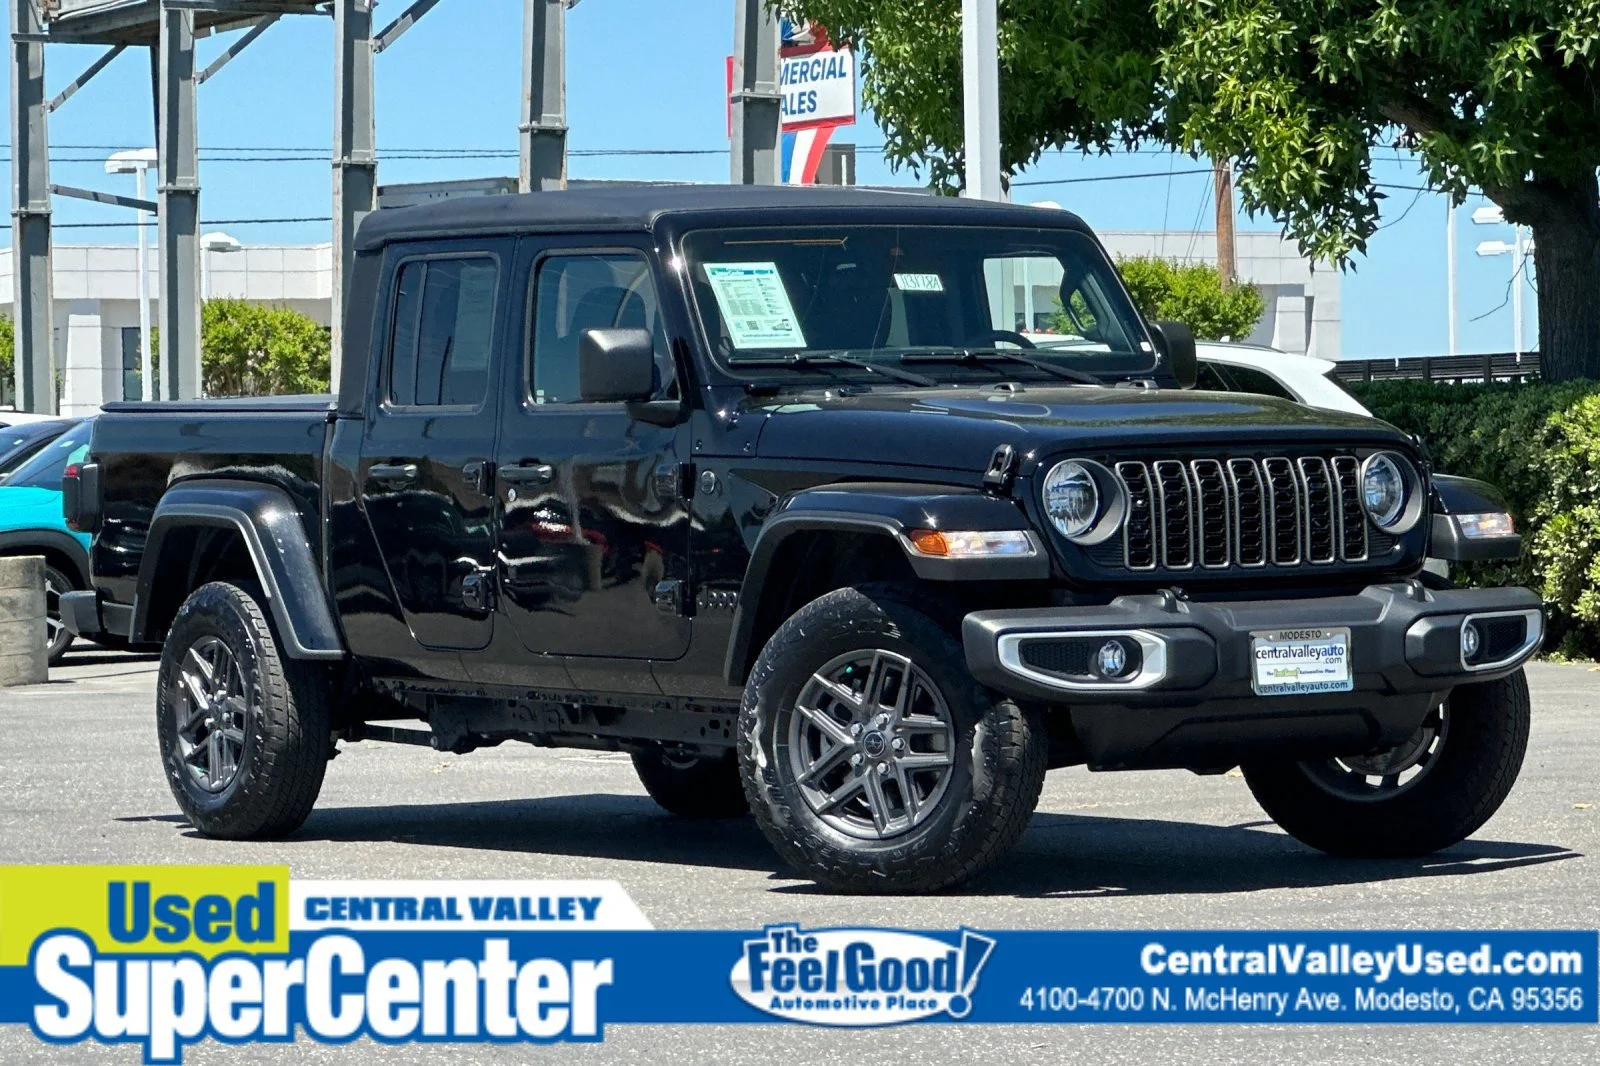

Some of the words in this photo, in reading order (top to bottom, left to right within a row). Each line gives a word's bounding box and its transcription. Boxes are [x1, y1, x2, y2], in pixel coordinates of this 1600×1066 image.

[1279, 630, 1322, 640] MODESTO
[1256, 645, 1344, 660] centralvalleyauto
[1322, 657, 1342, 665] .com
[1259, 681, 1348, 694] centralvalleyauto.com
